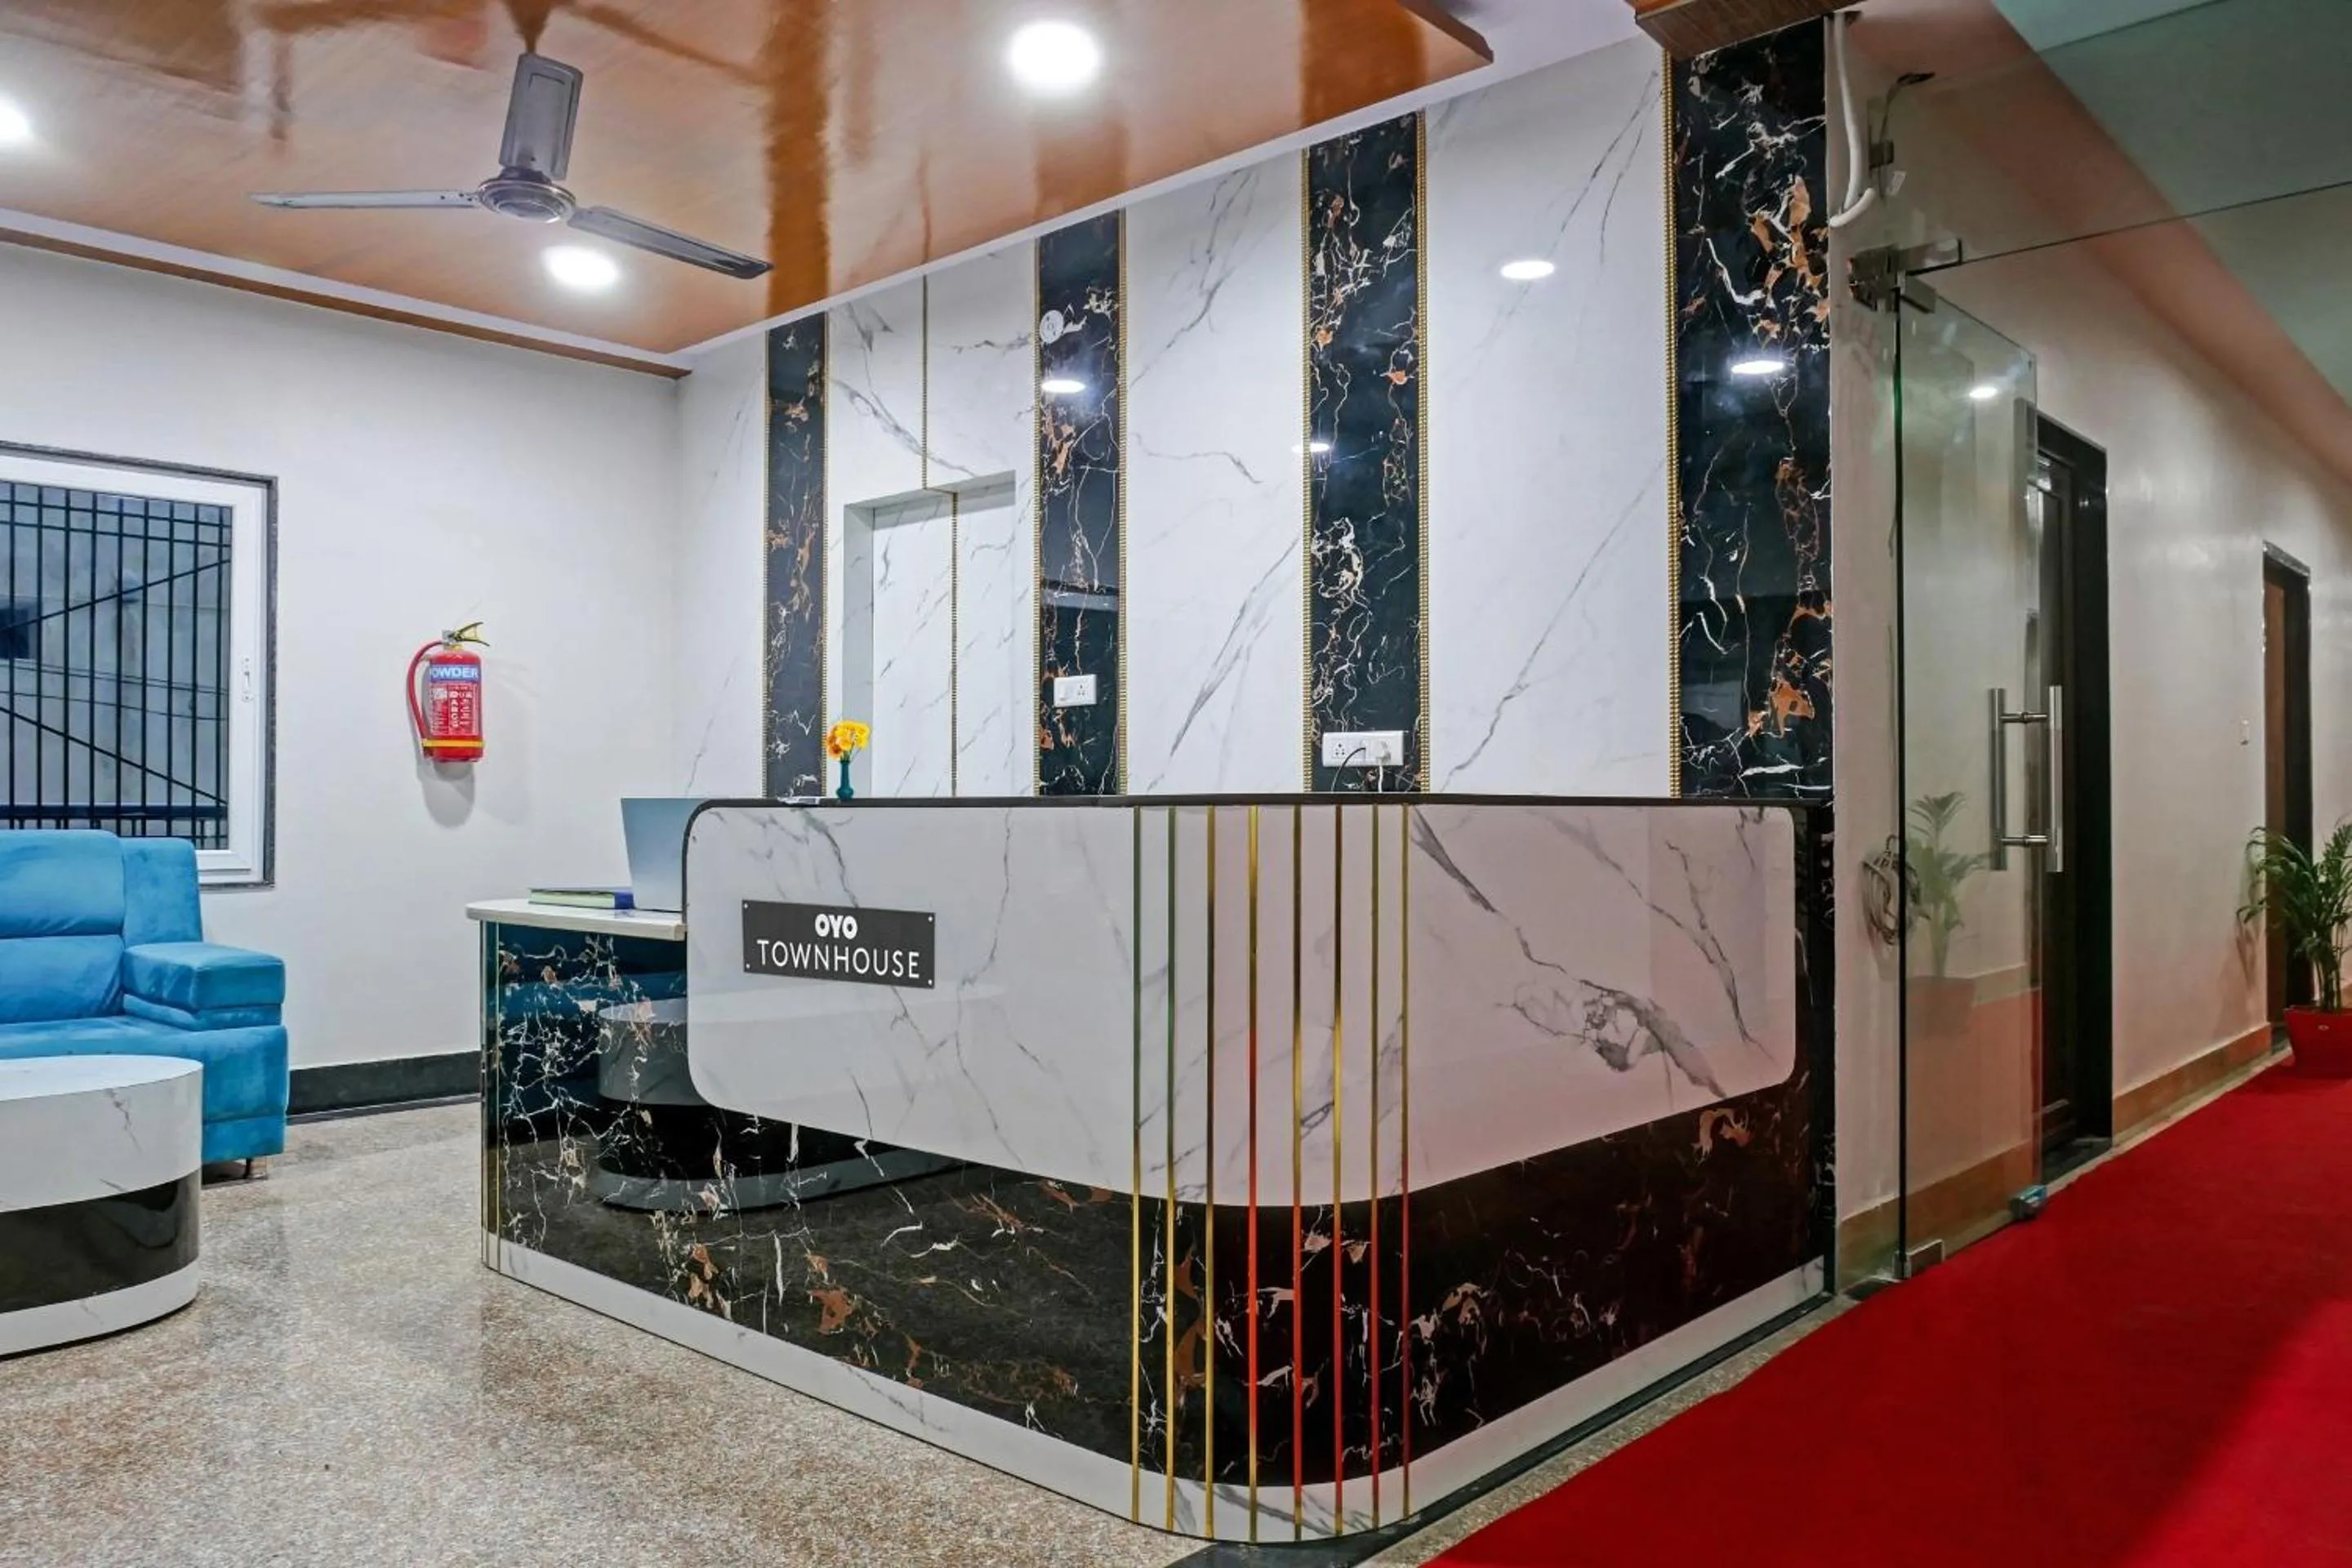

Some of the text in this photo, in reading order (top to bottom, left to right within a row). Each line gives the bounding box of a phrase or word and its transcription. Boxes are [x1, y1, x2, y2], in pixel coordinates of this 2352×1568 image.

[431, 666, 478, 679] OWDER
[815, 914, 858, 939] OYO
[757, 939, 920, 978] TOWNHOUSE
